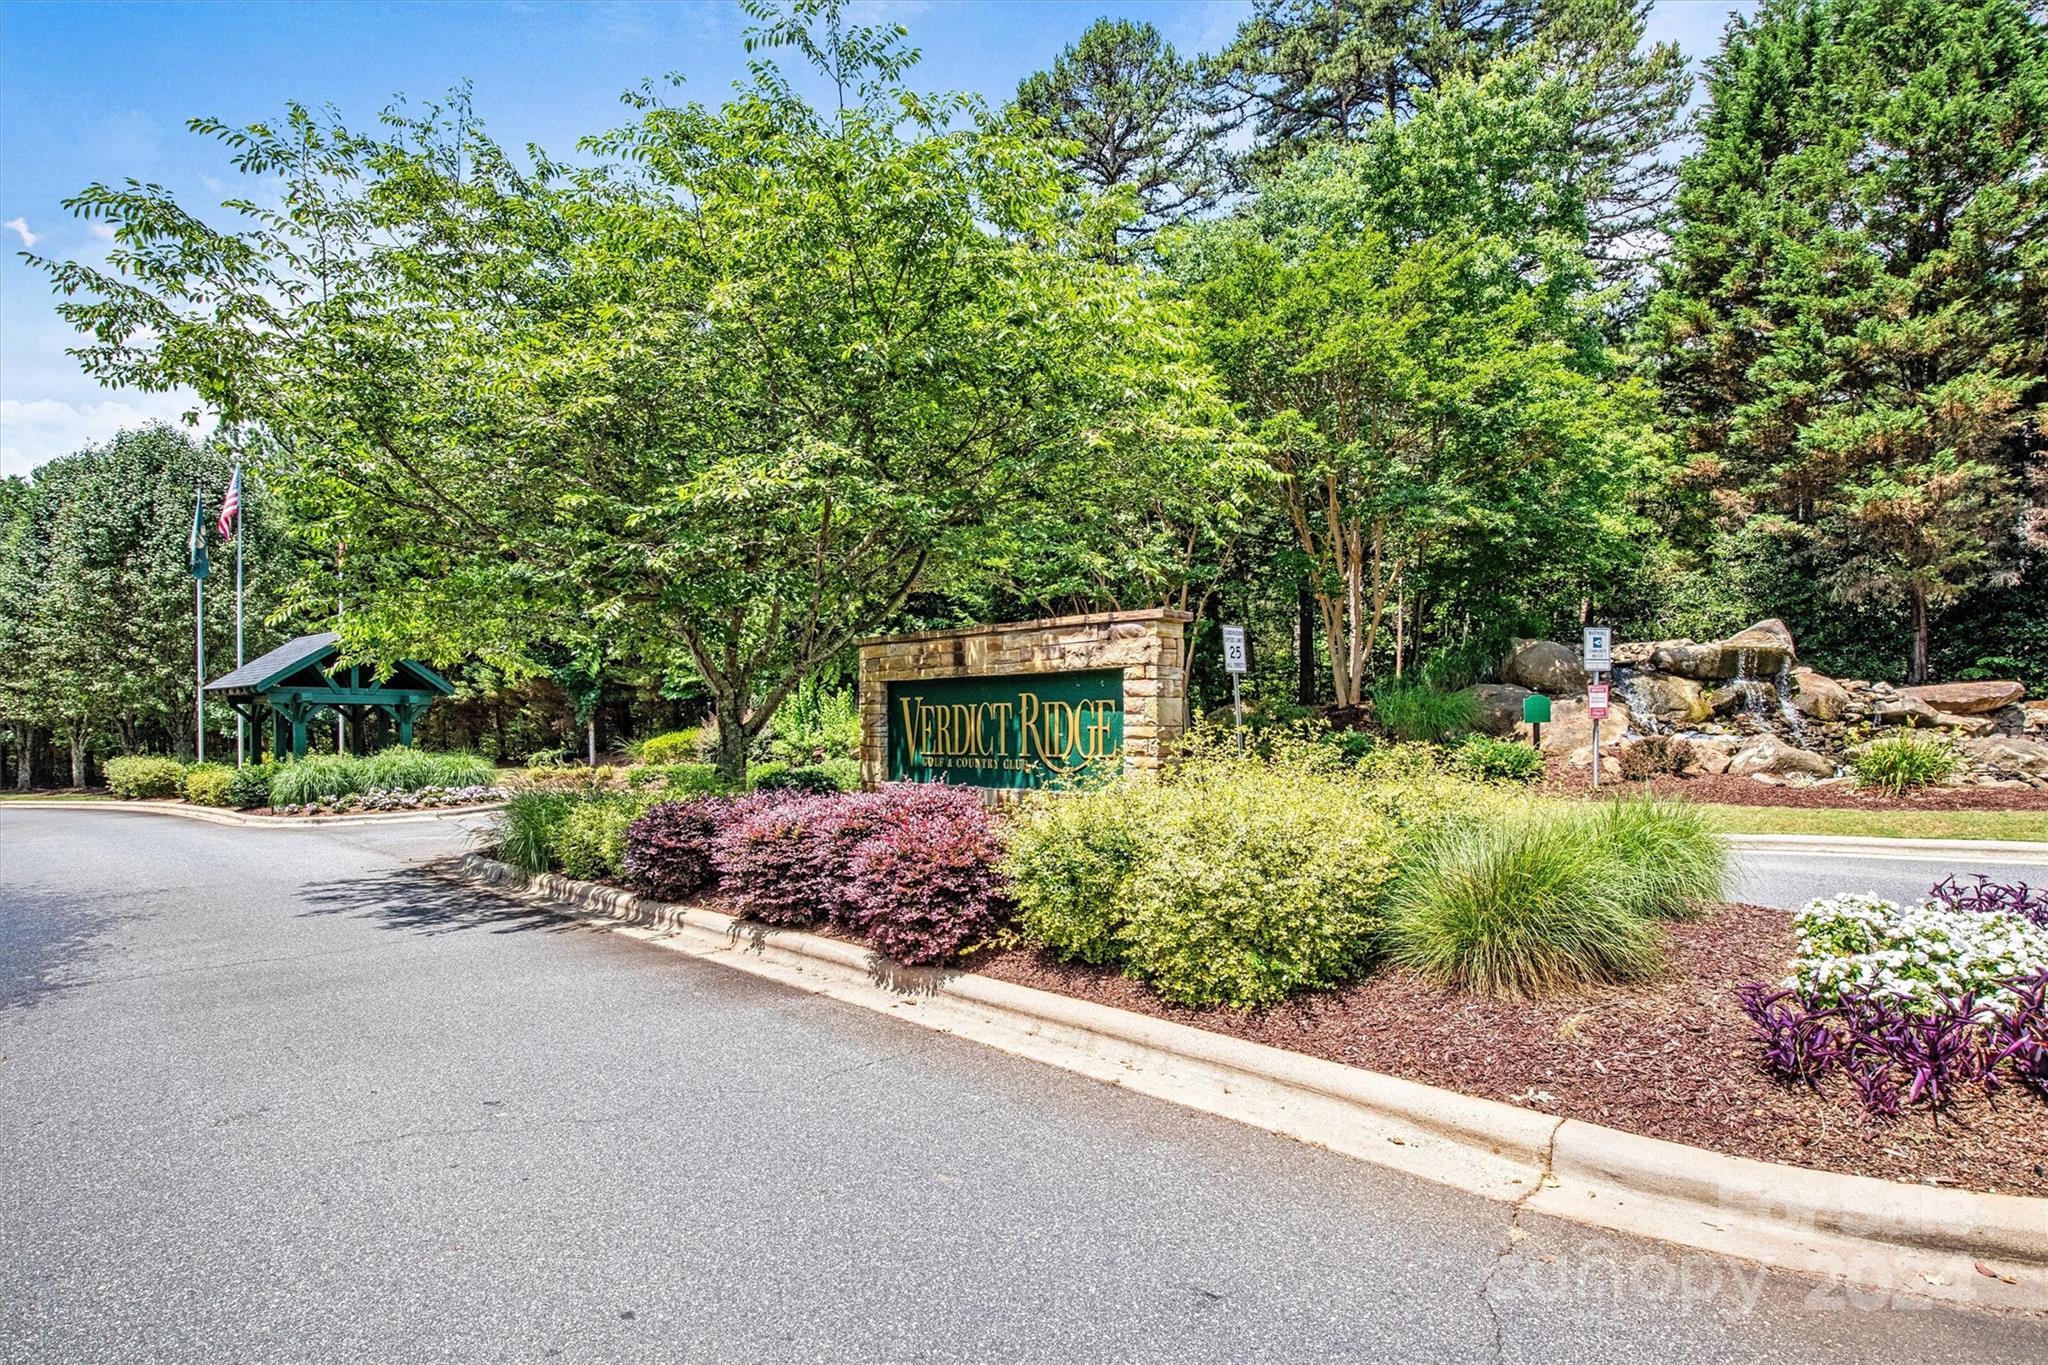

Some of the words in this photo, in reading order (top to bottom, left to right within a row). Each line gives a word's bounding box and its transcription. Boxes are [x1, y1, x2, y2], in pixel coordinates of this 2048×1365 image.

[1230, 646, 1241, 659] 25
[900, 697, 1012, 765] VERDICT
[1018, 693, 1116, 773] RIDGE
[922, 756, 944, 768] GOLF
[947, 758, 952, 768] &
[956, 757, 998, 769] COUNTRY
